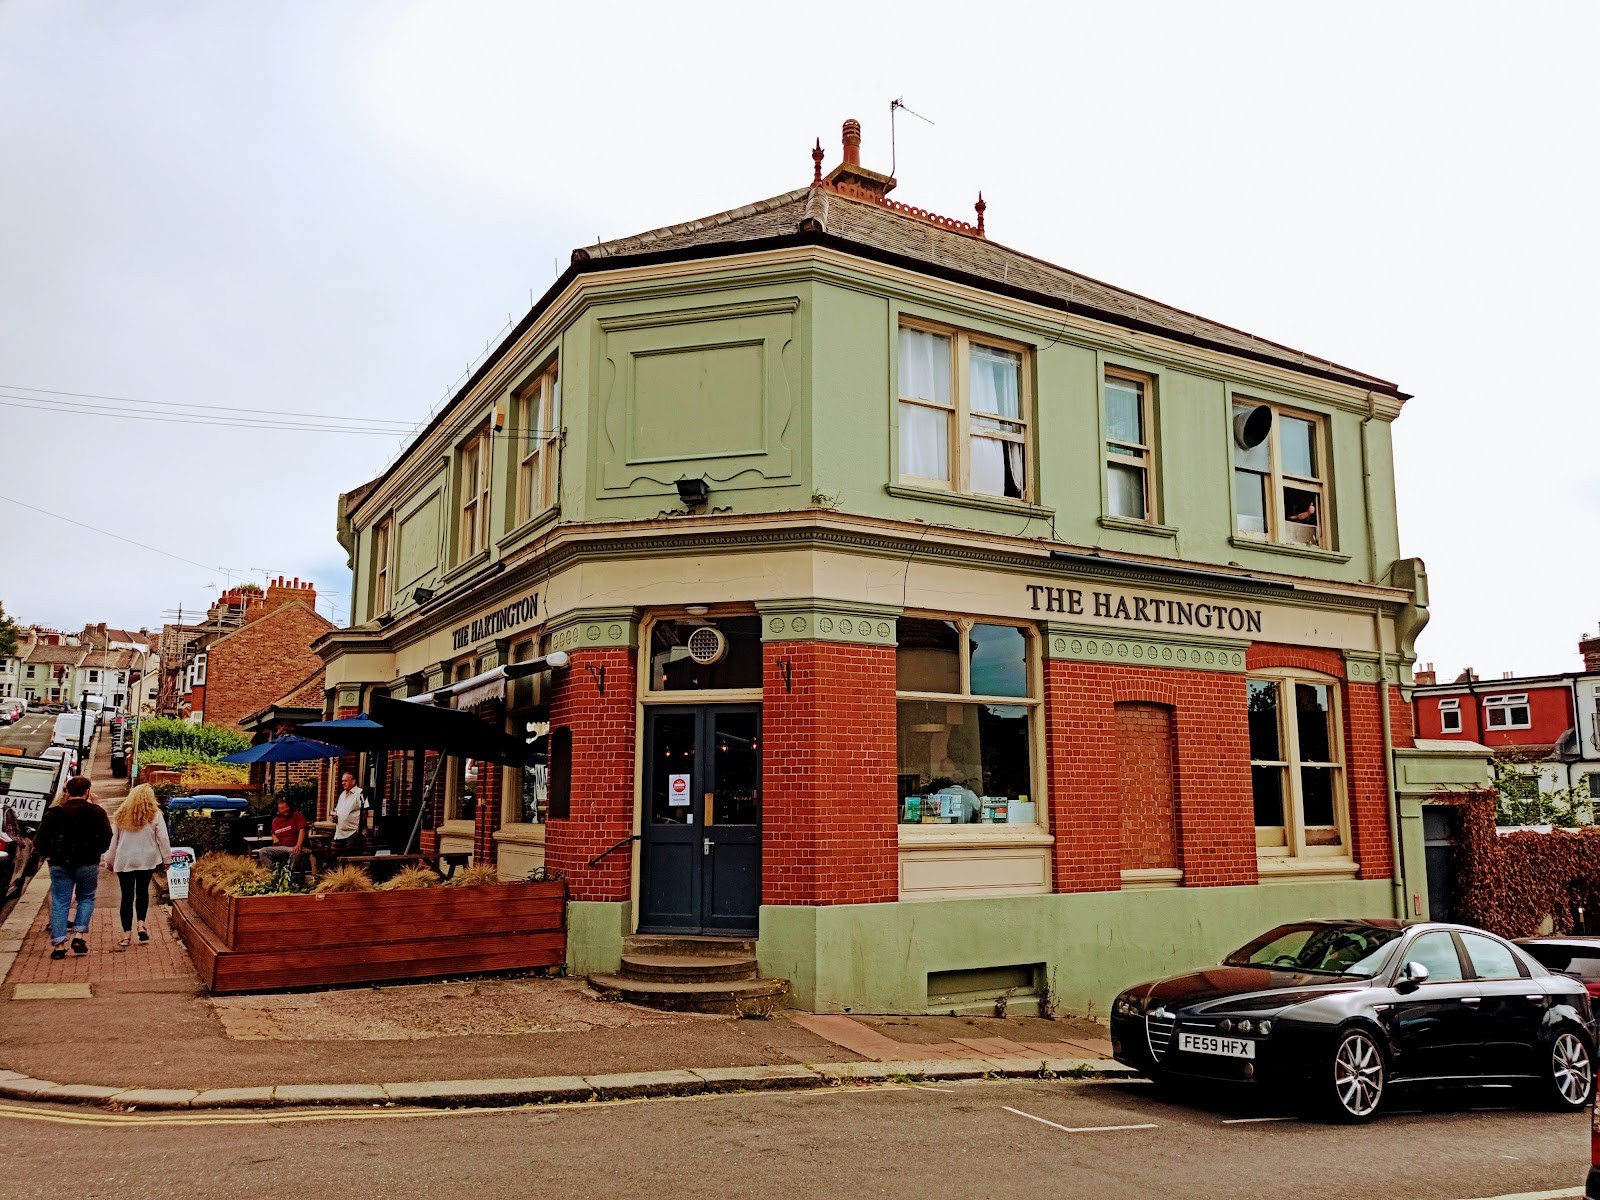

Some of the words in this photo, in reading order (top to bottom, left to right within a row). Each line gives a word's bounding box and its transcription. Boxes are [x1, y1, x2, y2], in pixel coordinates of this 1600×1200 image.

[452, 624, 469, 650] THE
[470, 592, 539, 643] HARTINGTON
[1026, 584, 1083, 614] THE
[1092, 591, 1262, 632] HARTINGTON
[1184, 1035, 1218, 1051] FE59
[1221, 1039, 1248, 1055] HFX
